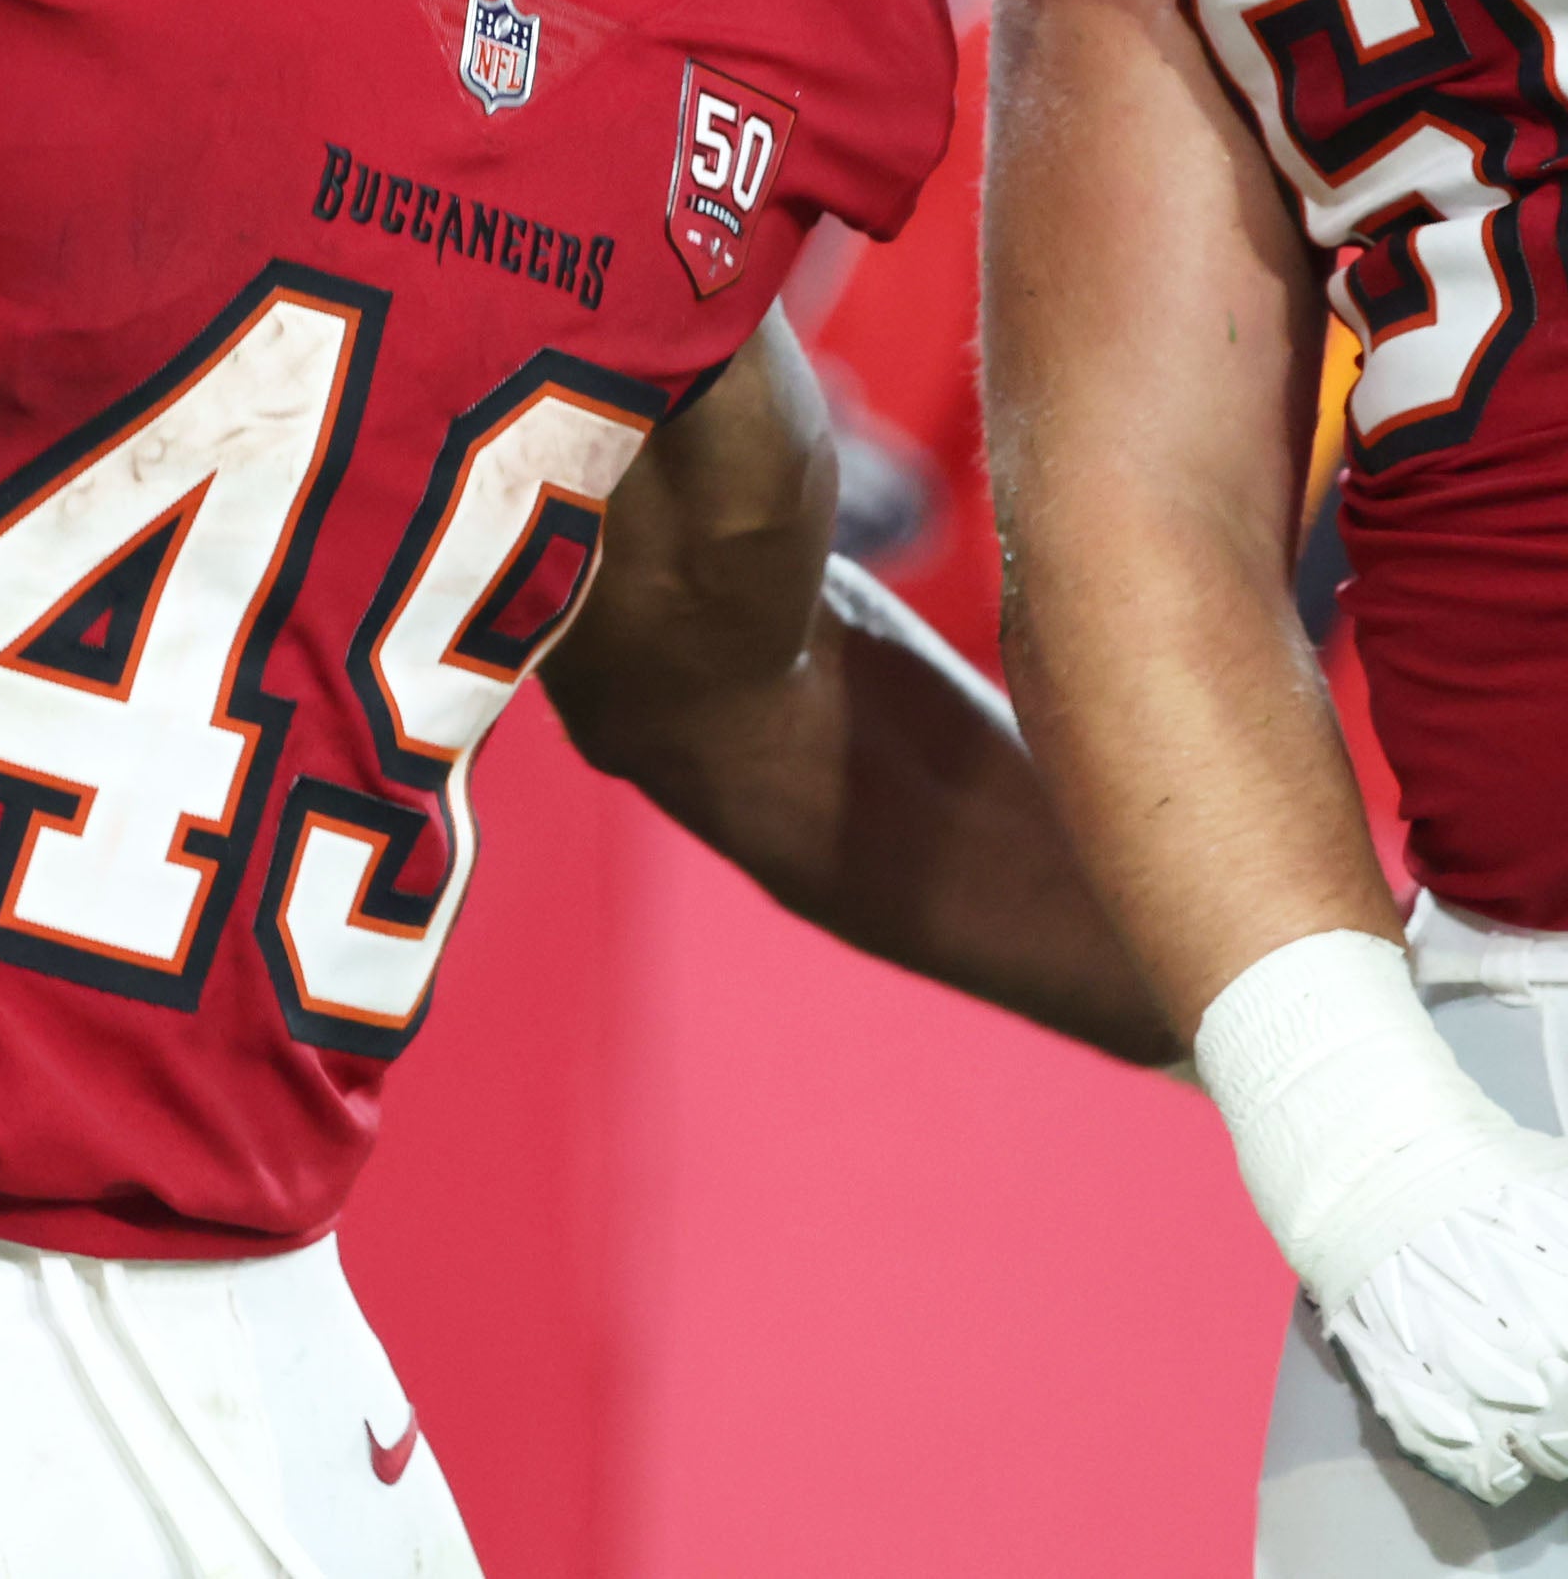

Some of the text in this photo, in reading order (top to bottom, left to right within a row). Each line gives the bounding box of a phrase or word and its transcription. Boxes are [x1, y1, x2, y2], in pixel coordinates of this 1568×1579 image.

[475, 39, 522, 90] NFL
[691, 91, 774, 212] 50
[312, 141, 615, 310] BUCCANEERS
